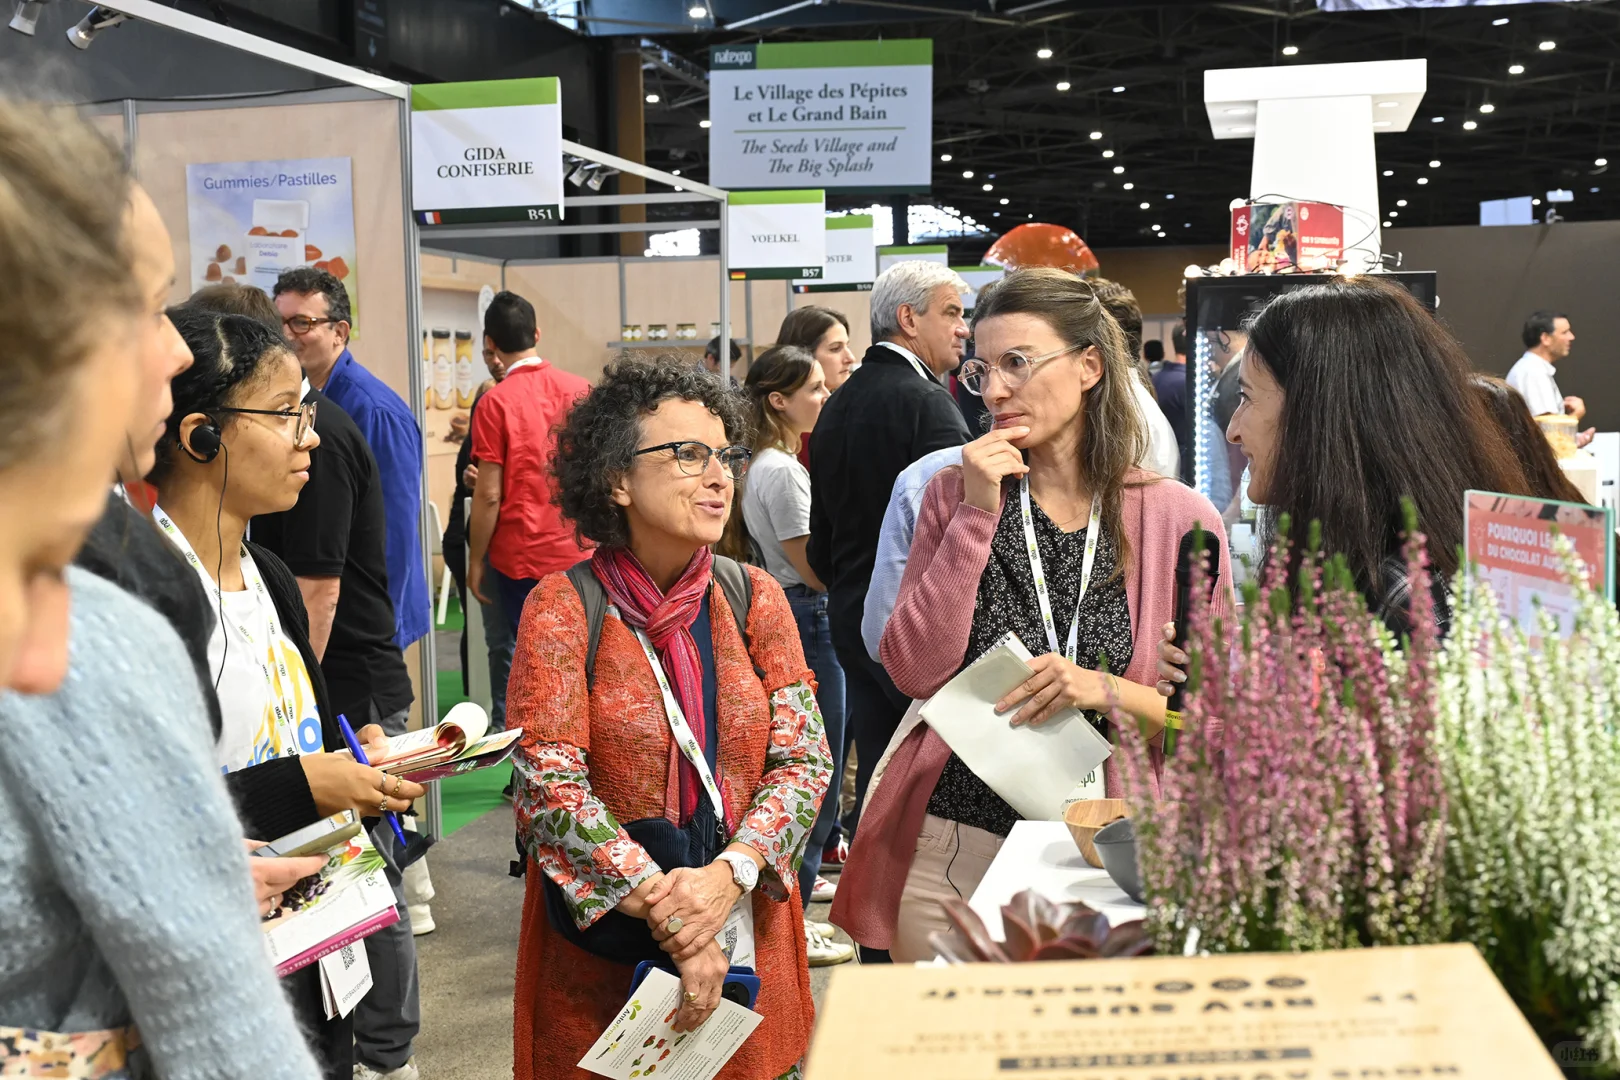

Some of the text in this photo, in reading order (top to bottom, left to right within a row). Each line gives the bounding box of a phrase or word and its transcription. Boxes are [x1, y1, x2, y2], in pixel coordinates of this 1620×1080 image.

[733, 81, 908, 104] Le Village des Pépites
[748, 105, 887, 123] et Le Grand Bain
[464, 147, 506, 161] GIDA
[742, 136, 898, 158] The Seeds Village and
[437, 161, 534, 178] CONFISERIE
[769, 156, 874, 177] The Big Splash
[203, 172, 337, 190] Gummies/Pastilles
[527, 208, 553, 220] B51
[752, 233, 800, 243] VOELKEL
[802, 268, 820, 278] B57
[1487, 522, 1538, 547] POURQUOI
[1488, 544, 1498, 557] DU
[1500, 546, 1541, 566] CHOCOLAT
[354, 924, 382, 939] Natexpo
